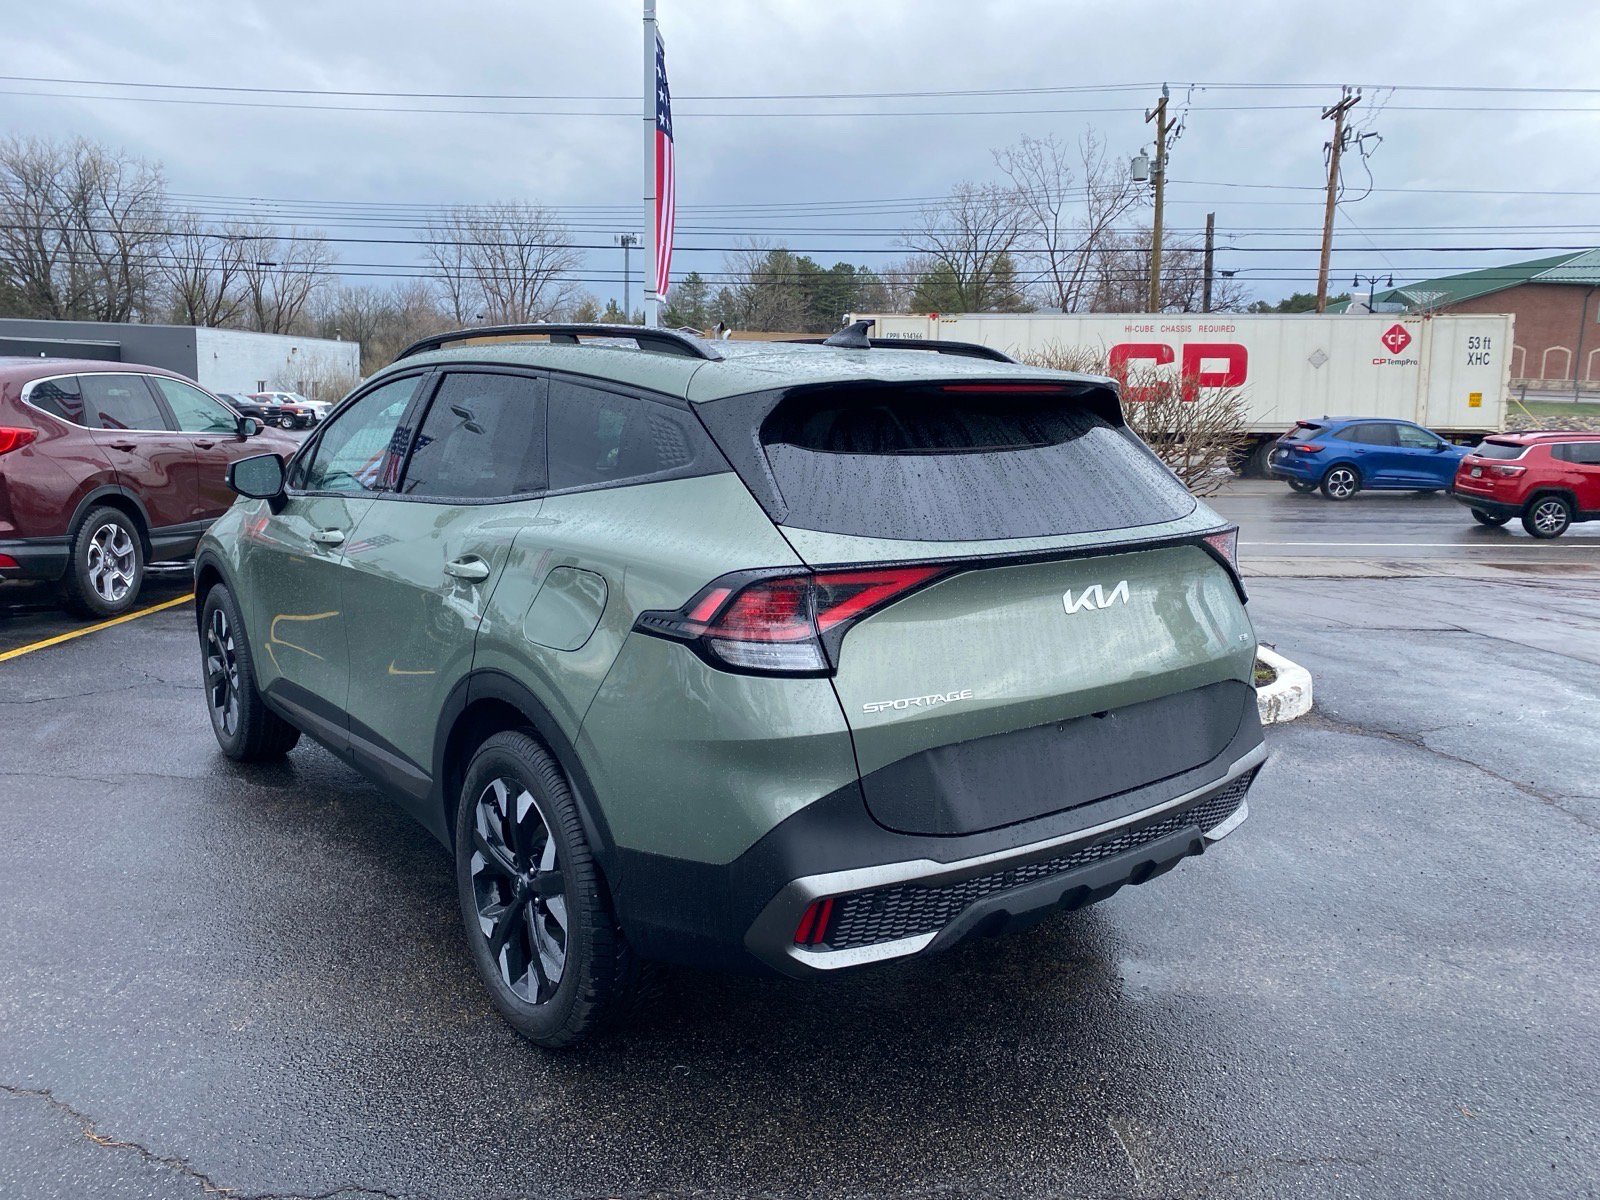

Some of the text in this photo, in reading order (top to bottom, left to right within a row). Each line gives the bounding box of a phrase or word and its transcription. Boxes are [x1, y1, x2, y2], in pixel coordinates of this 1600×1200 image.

[1124, 325, 1236, 333] HI-CUBE CHASSIS REQUIRED
[1468, 336, 1491, 350] 53 ft
[1387, 358, 1418, 367] TempPro
[1467, 352, 1490, 366] XHC
[1109, 343, 1248, 402] CP
[1062, 580, 1130, 615] KIA
[862, 689, 974, 714] SPORTAGE
